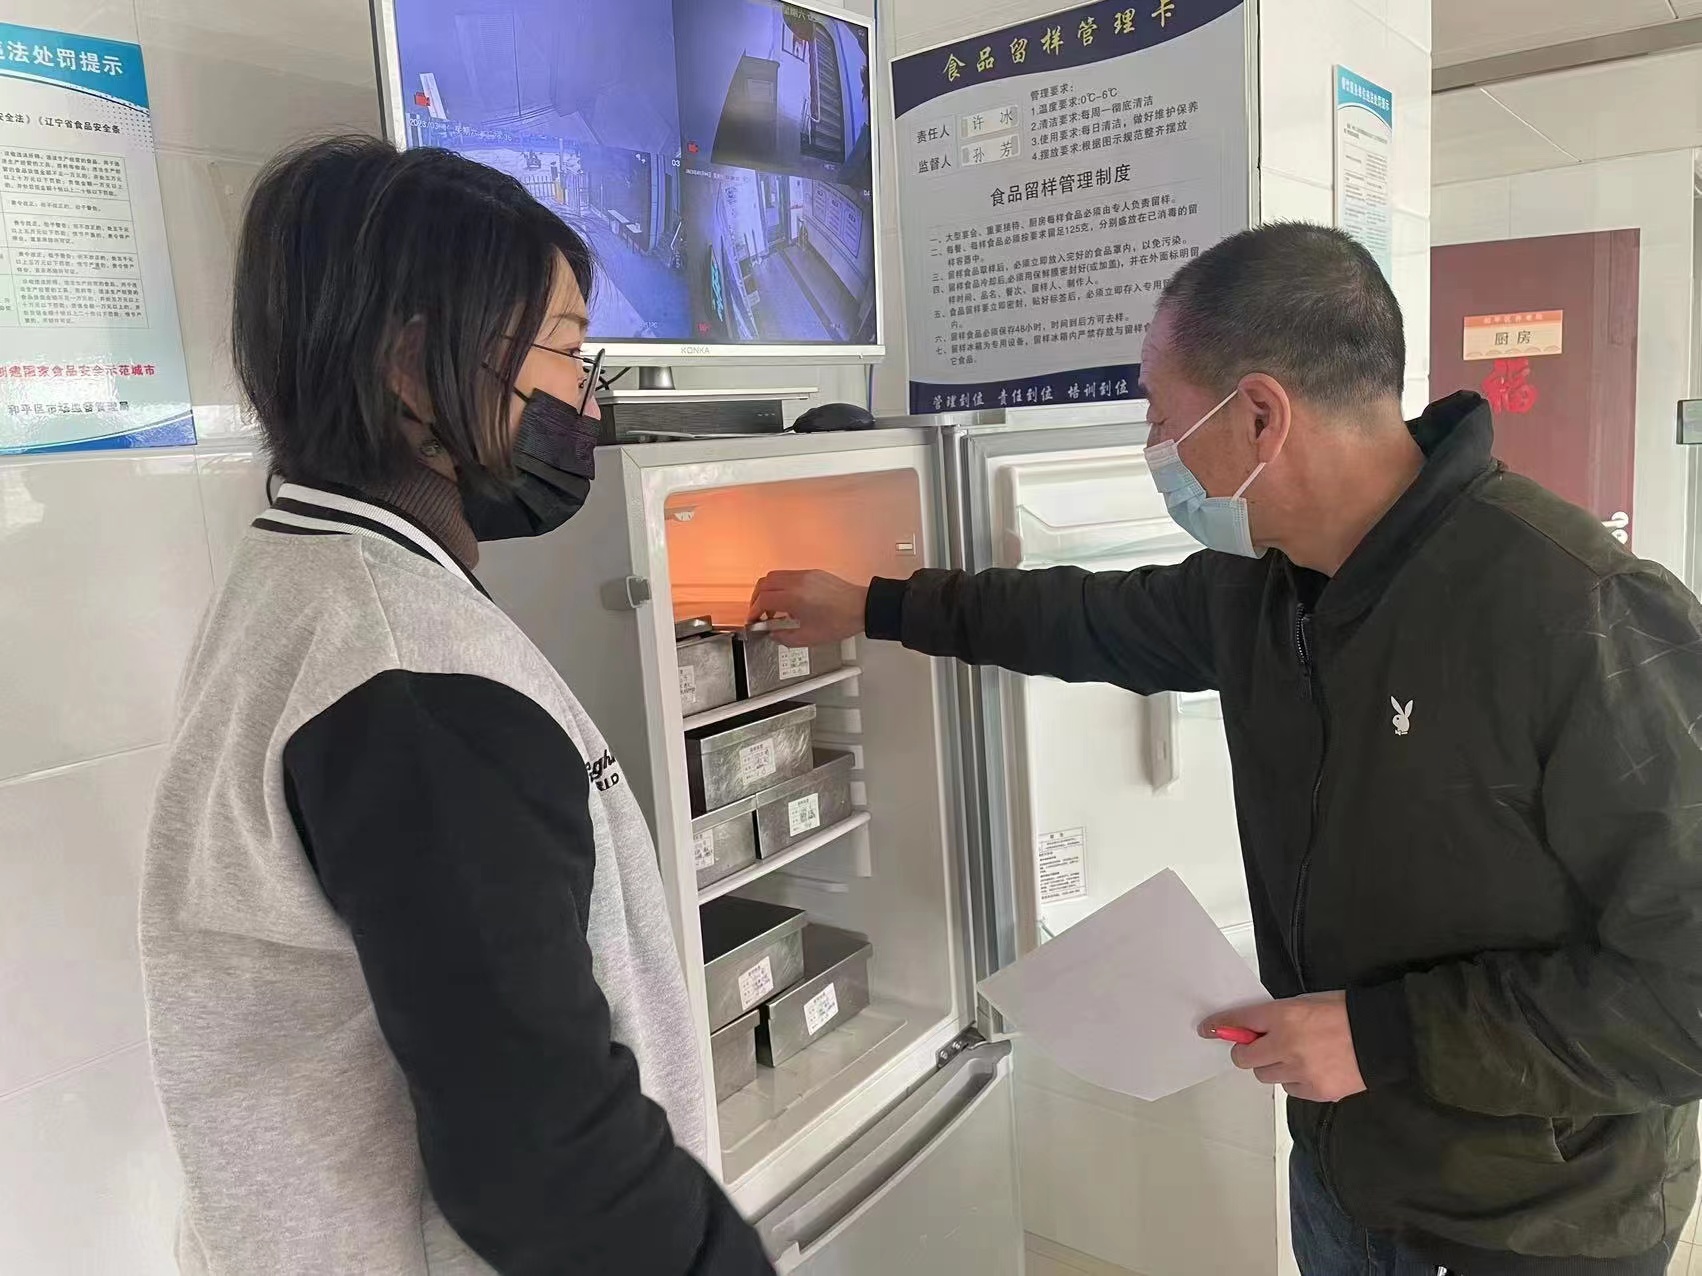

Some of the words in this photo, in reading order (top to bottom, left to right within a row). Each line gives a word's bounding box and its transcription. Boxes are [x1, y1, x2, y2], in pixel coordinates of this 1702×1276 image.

[942, 0, 1177, 82] 食品留样管理卡
[0, 40, 124, 76] 法处罚提示
[0, 111, 121, 134] 全法》《辽宁省食品安全条
[917, 124, 950, 143] 责任人
[918, 153, 951, 173] 监督人
[990, 163, 1132, 207] 食品留样管理制度
[680, 346, 711, 355] KONKA
[931, 391, 985, 410] 管理到位
[997, 385, 1054, 406] 责任到位
[1068, 380, 1130, 399] 培训到位
